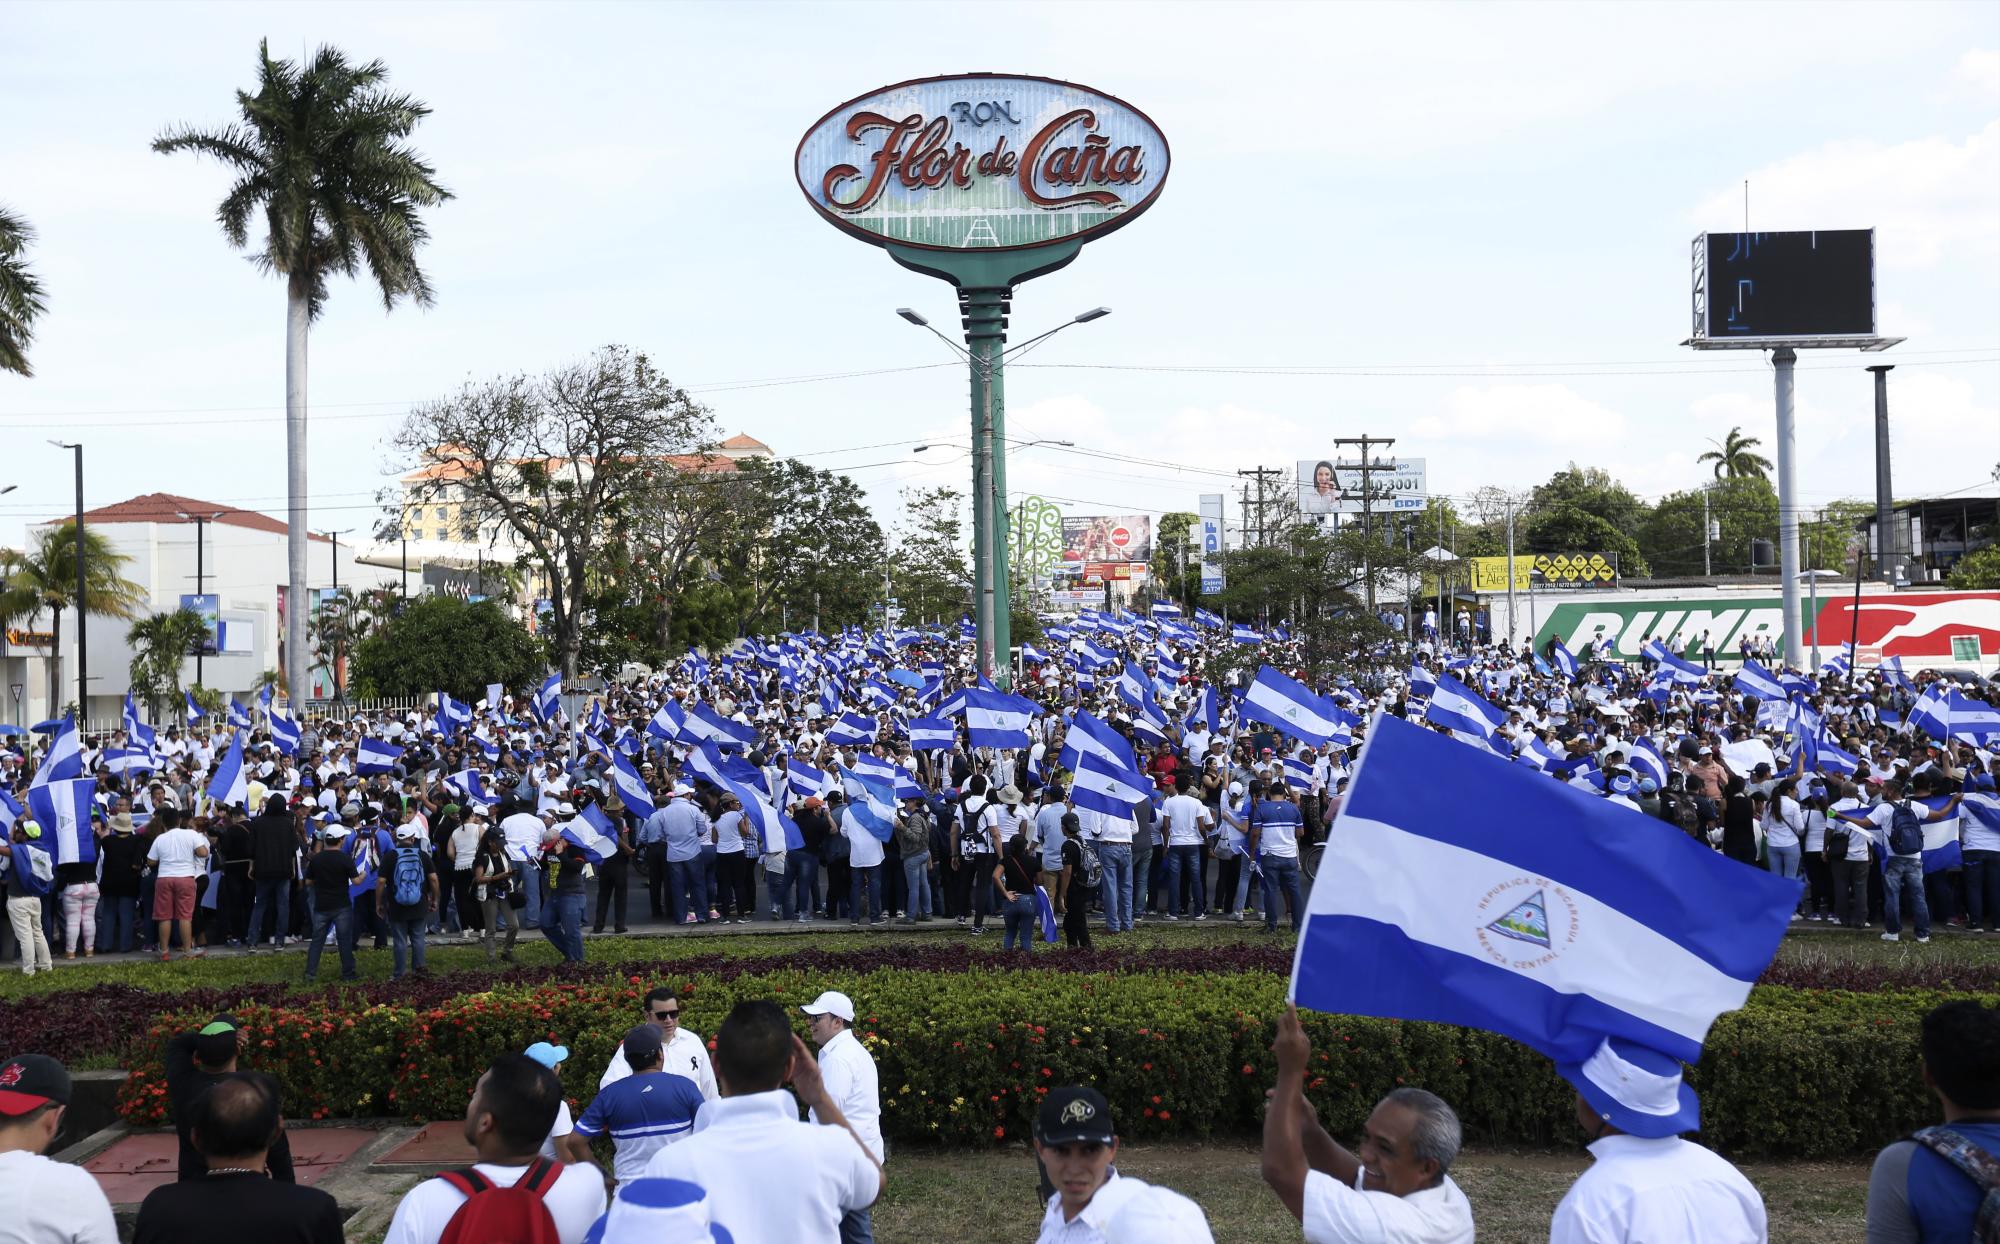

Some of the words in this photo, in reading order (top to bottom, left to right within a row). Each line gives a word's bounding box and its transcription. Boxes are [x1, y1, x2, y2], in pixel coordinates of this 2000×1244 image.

[951, 100, 1021, 127] RON
[823, 111, 974, 214] Flor
[976, 135, 1017, 176] de
[1019, 108, 1147, 211] Caña
[1394, 499, 1423, 508] BDF
[1478, 878, 1530, 911] REPUBLICA
[1535, 878, 1551, 888] DE
[1554, 886, 1579, 943] NICARAGUA
[1476, 926, 1507, 964] AMERICA
[1513, 951, 1560, 969] CENTRAL
